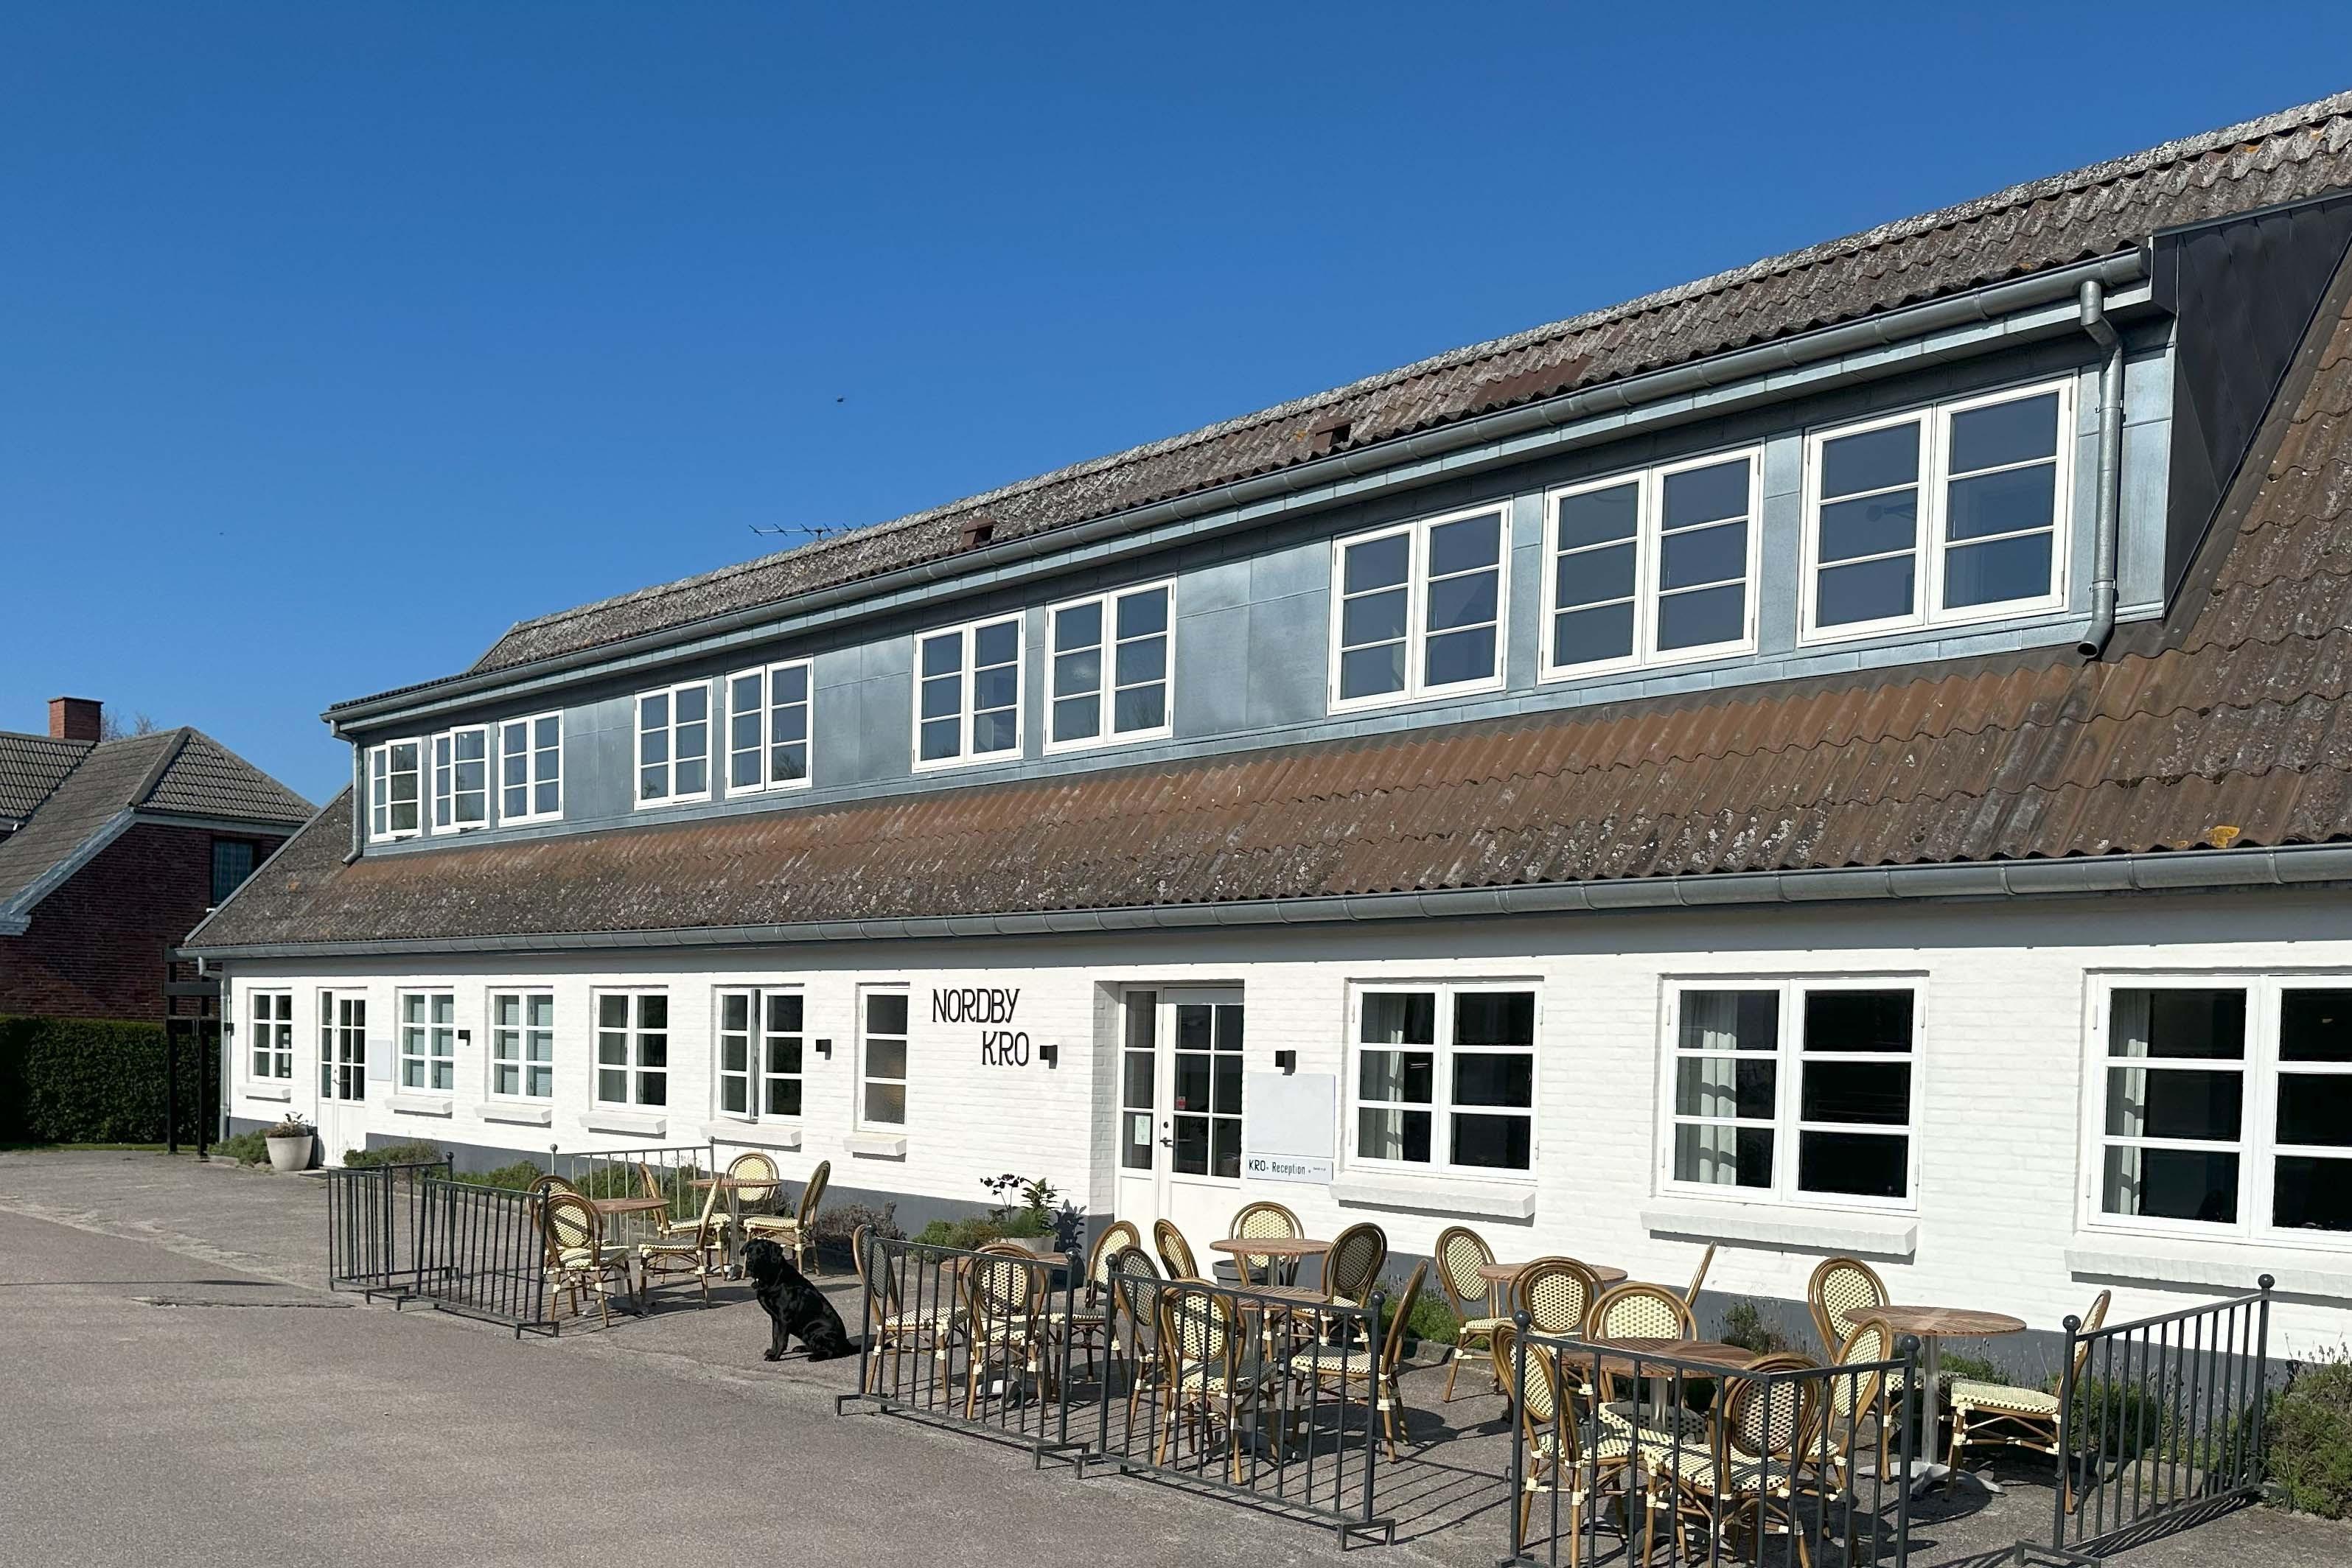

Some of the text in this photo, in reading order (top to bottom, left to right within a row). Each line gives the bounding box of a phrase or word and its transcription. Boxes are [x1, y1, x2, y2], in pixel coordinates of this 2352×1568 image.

[932, 989, 1020, 1023] NORDBY
[982, 1031, 1029, 1066] KRO
[1272, 1161, 1305, 1176] Reception
